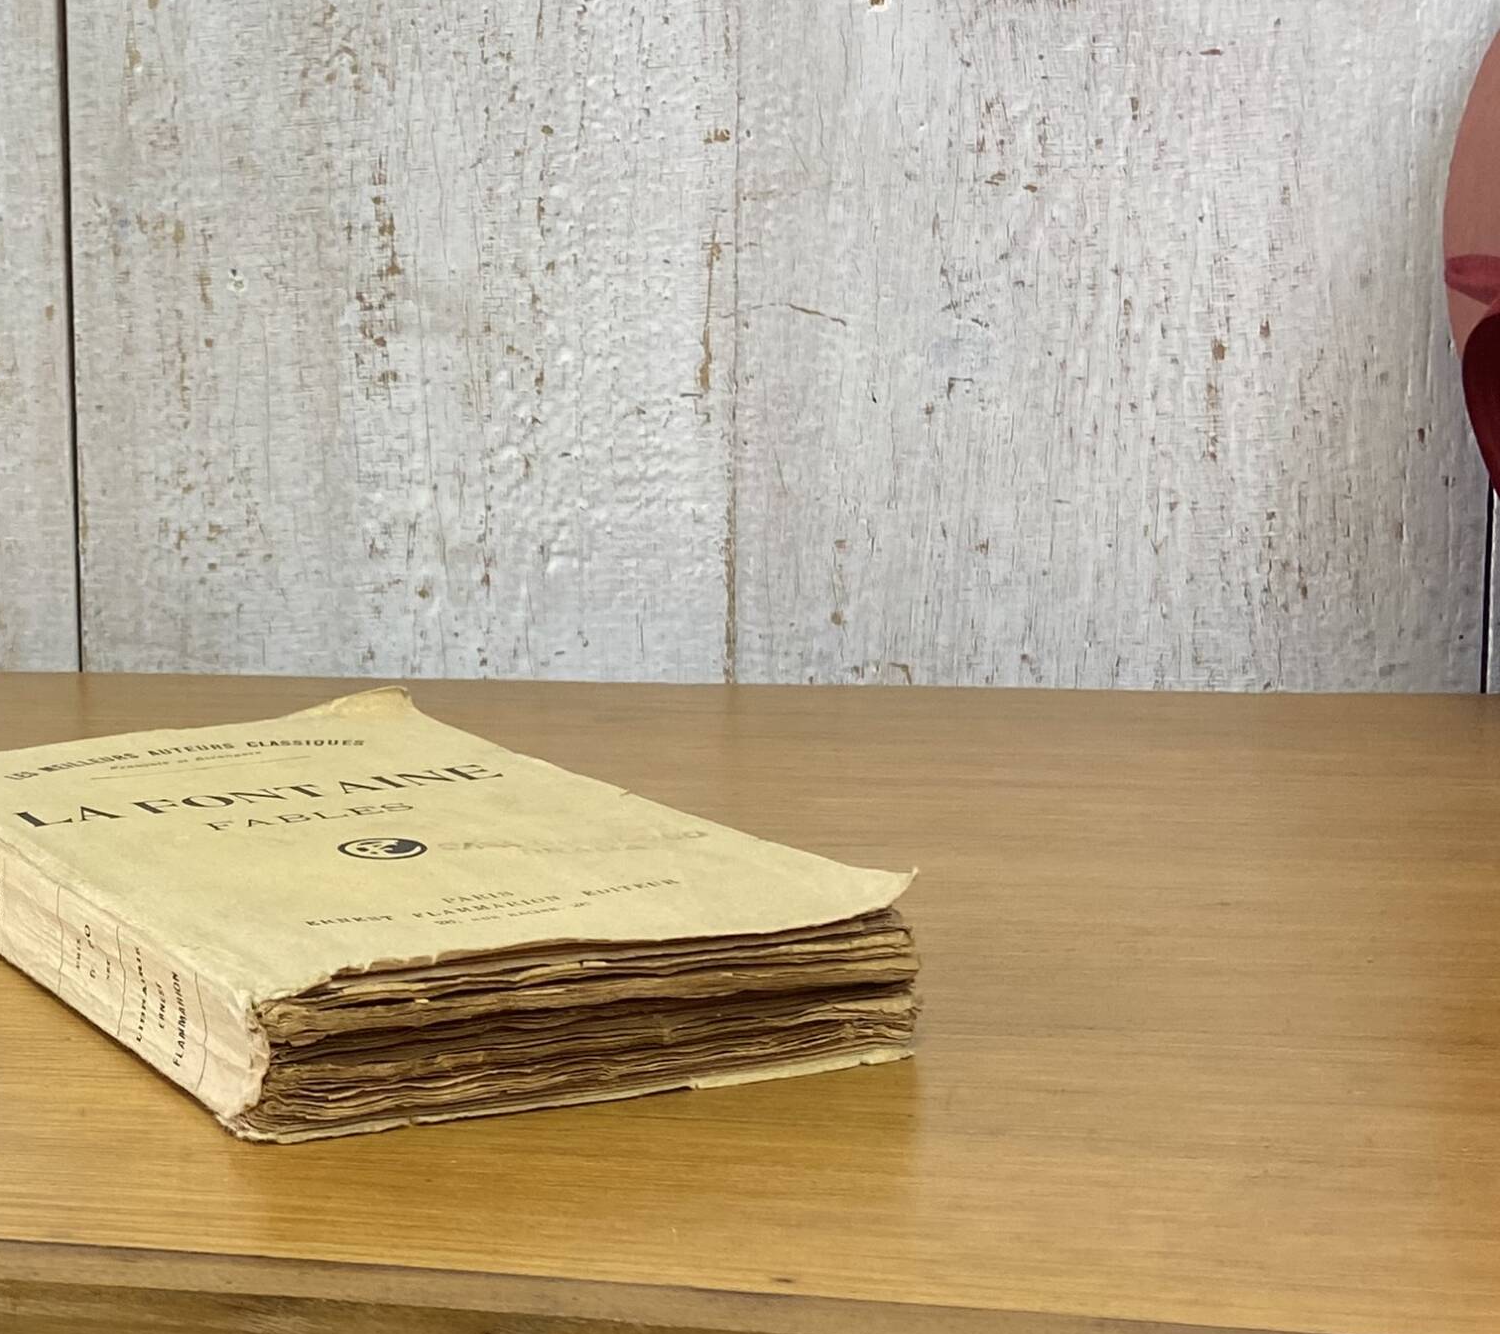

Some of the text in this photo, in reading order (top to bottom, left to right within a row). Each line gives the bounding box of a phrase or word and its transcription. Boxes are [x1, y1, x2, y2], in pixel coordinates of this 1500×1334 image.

[37, 752, 140, 773] MEILLEURS
[147, 741, 236, 757] AUTEURS
[245, 738, 366, 748] CLASSIQUES
[14, 763, 504, 827] LA FONTAINE
[203, 802, 415, 831] FABLES
[411, 894, 562, 919] FLAMMARION
[441, 890, 515, 904] PARIS
[171, 970, 188, 1068] FLAMMARION
